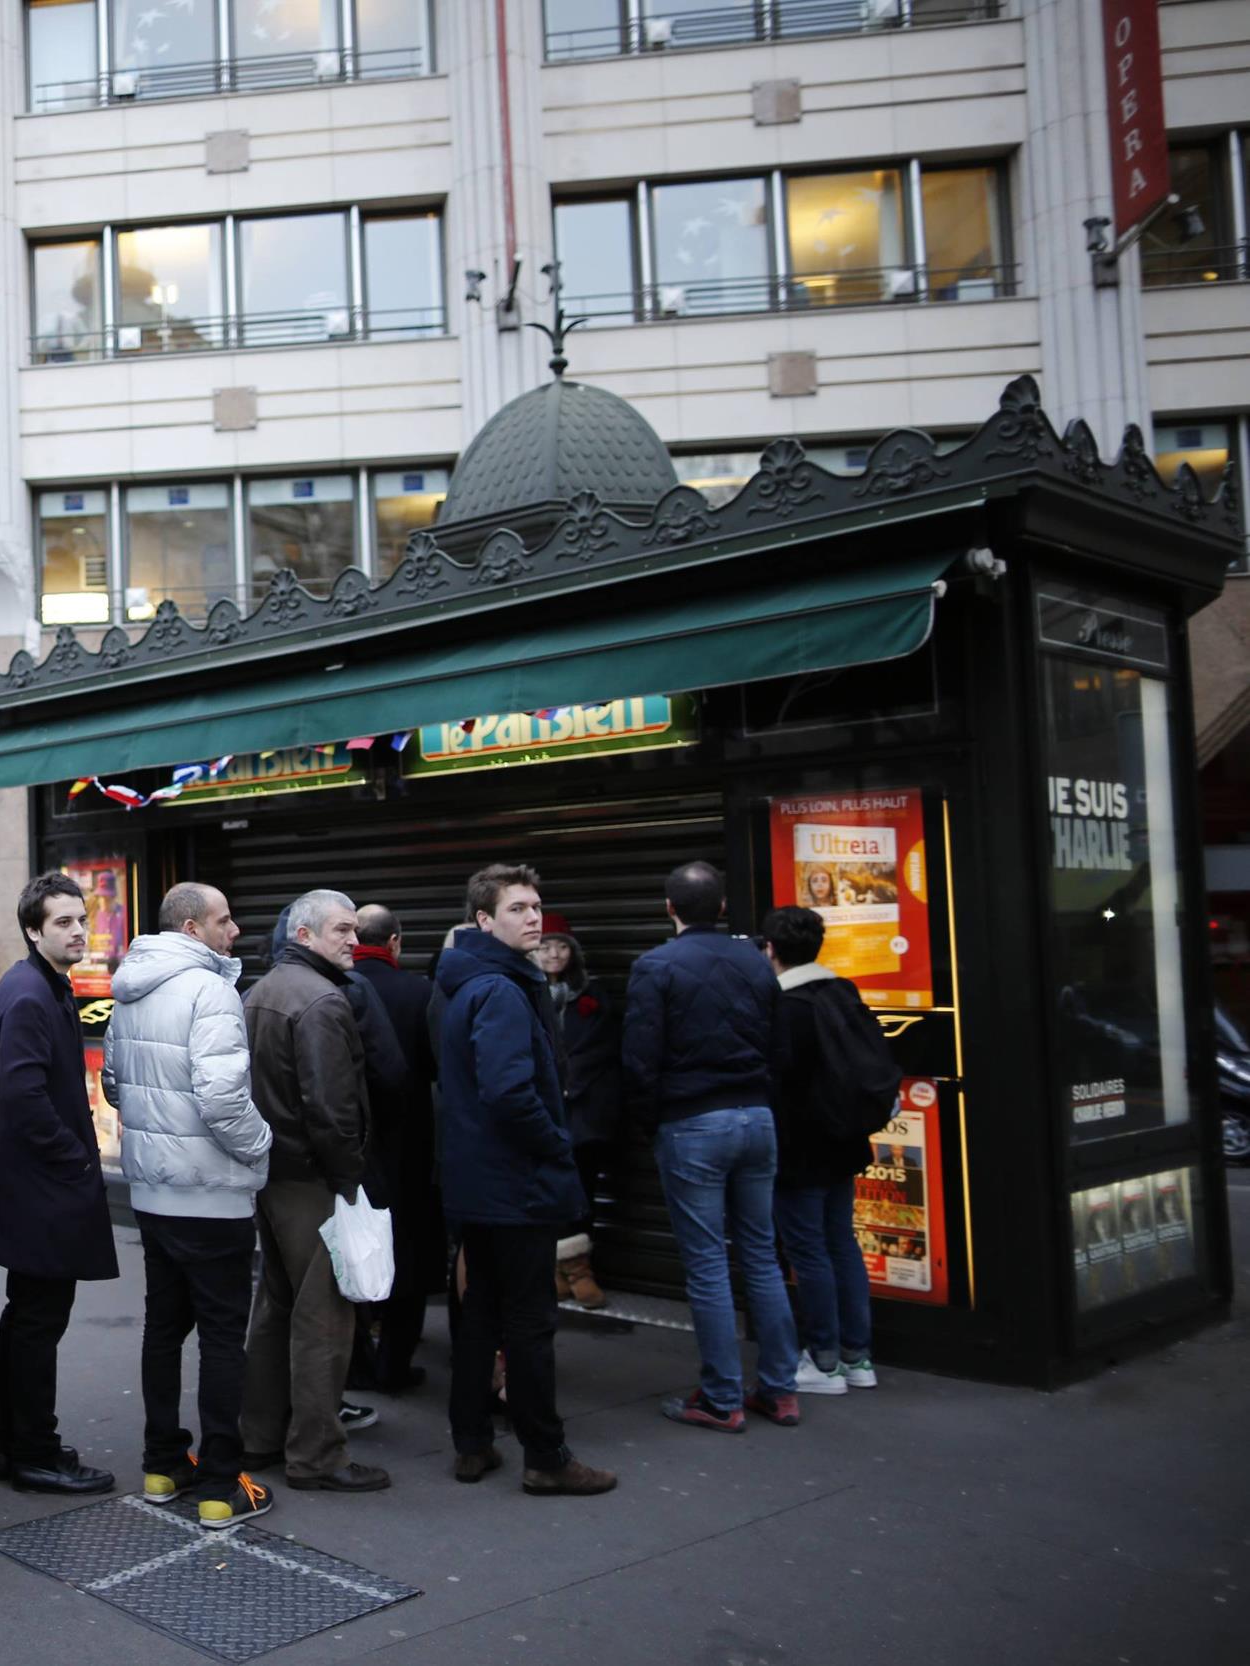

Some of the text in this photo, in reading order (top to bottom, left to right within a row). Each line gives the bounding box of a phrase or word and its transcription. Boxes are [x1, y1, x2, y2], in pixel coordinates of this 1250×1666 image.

[1114, 16, 1147, 199] OPERA
[781, 802, 807, 815] PLUS
[841, 799, 871, 811] PLUS
[872, 795, 908, 809] HAUT
[1074, 778, 1128, 819] SUIS
[1050, 816, 1132, 871] HARLIE
[865, 1165, 907, 1183] 2015
